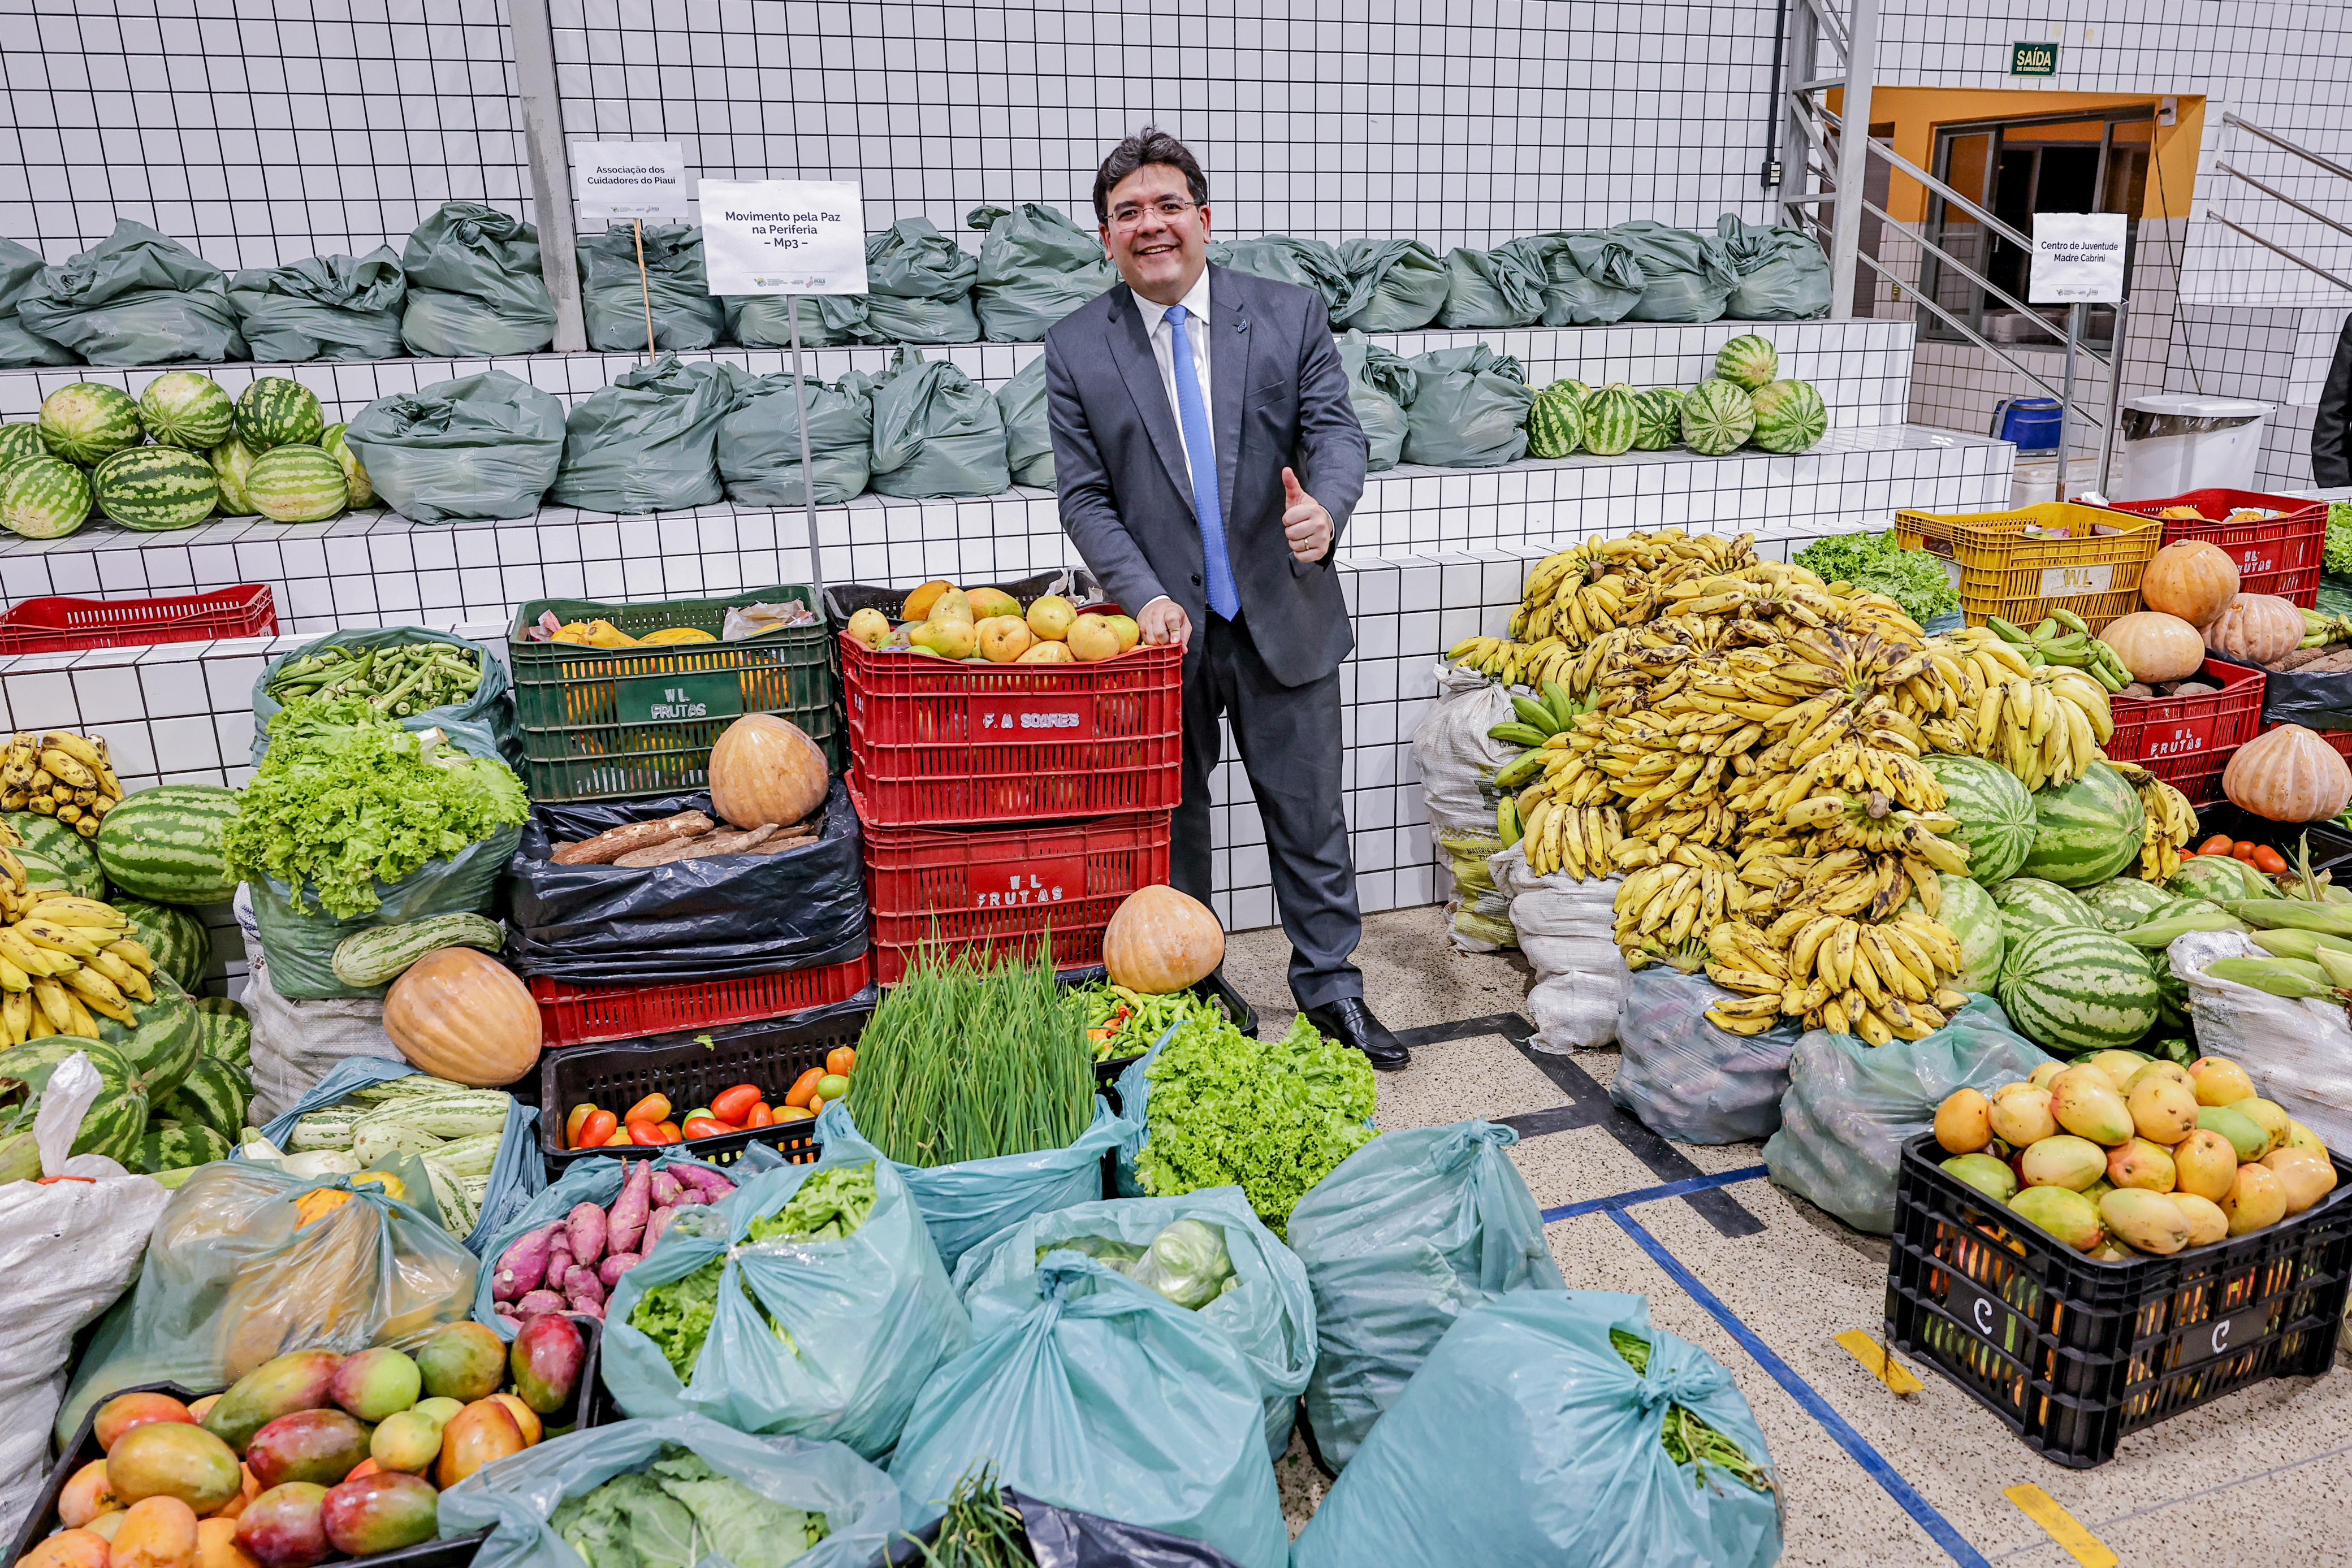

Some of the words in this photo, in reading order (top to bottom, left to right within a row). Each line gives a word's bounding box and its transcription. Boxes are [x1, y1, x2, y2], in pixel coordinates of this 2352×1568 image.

[2017, 46, 2051, 66] SAÍDA
[596, 166, 646, 175] Associação
[725, 211, 790, 221] Movimento
[793, 212, 818, 223] pela
[821, 212, 841, 222] Paz
[769, 224, 818, 234] Periferia
[774, 237, 798, 249] Mp3
[2041, 241, 2068, 249] Centro
[2069, 241, 2079, 250] de
[2081, 242, 2118, 250] Juventude
[2081, 254, 2105, 262] Cabrini
[651, 703, 707, 720] FRUTAS
[1020, 712, 1079, 729] SOARES
[2150, 737, 2202, 756] FRUTAS
[977, 886, 1063, 908] FRUTAS
[2211, 1319, 2230, 1354] C
